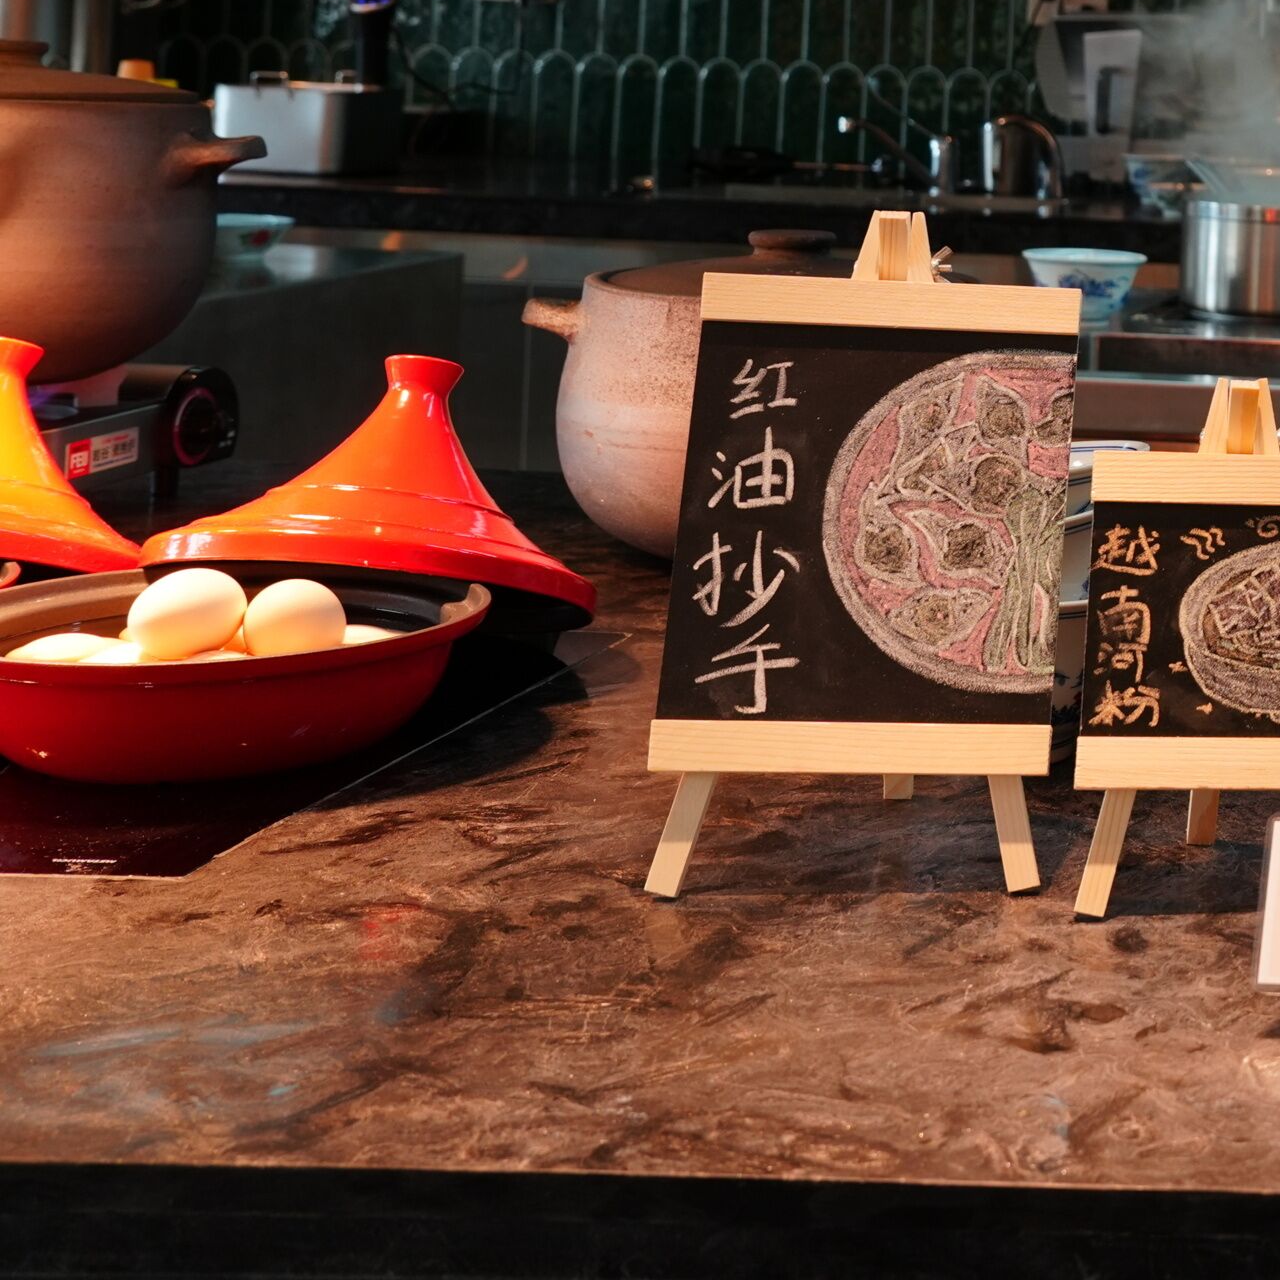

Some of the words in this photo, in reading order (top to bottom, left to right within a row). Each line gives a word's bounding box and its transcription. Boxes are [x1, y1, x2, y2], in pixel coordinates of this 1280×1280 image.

[693, 358, 801, 715] 红油抄手
[1088, 523, 1161, 728] 越南河粉
